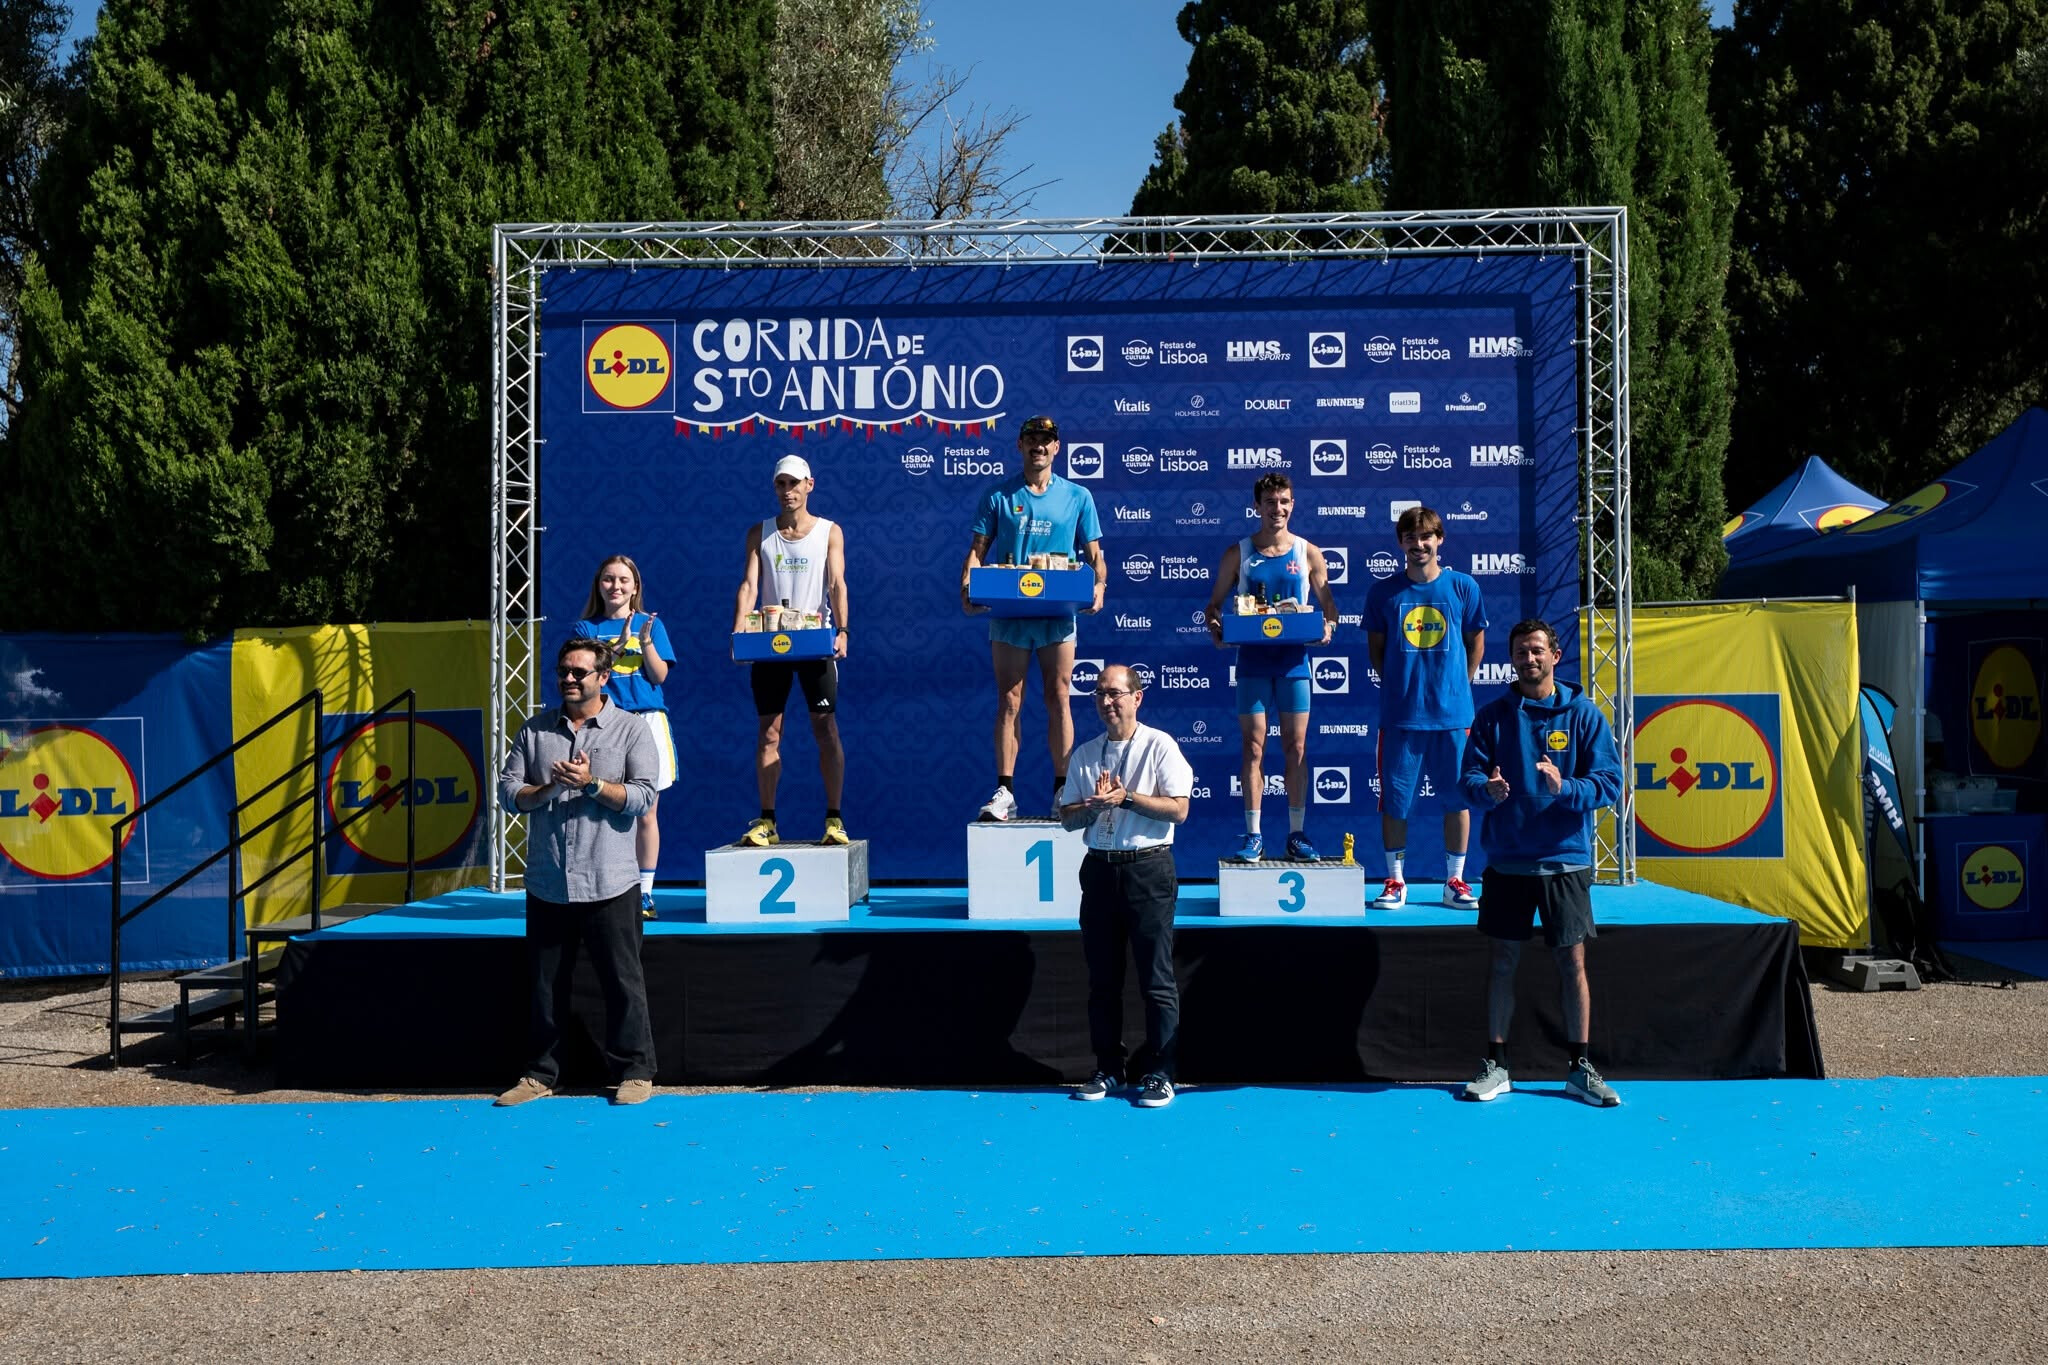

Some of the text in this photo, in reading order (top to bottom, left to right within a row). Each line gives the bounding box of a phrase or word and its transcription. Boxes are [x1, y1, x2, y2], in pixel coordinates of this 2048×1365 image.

[692, 317, 925, 363] CORRIDA DE
[1402, 337, 1439, 345] Festas de
[1121, 346, 1154, 355] LISBOA
[1159, 341, 1196, 350] Festas de
[1226, 340, 1281, 357] HMS
[1364, 343, 1396, 351] LISBOA
[1469, 337, 1523, 354] HMS
[1159, 350, 1208, 364] Lisboa
[1258, 353, 1291, 361] SPORTS
[1402, 346, 1451, 361] Lisboa
[1501, 349, 1534, 357] SPORTS
[692, 358, 1005, 413] STO ANTÓNIO
[1114, 398, 1150, 412] Vitalis
[1245, 400, 1291, 410] DOUBLET
[1320, 398, 1365, 408] RUNNERS
[944, 446, 990, 456] Festas de
[1160, 448, 1197, 456] Festas de
[1403, 445, 1440, 453] Festas de
[1470, 445, 1524, 462] HMS
[901, 454, 935, 463] LISBOA
[1122, 454, 1154, 462] LISBOA
[1227, 448, 1282, 465] HMS
[1365, 451, 1397, 459] LISBOA
[1160, 457, 1208, 472] Lisboa
[1259, 460, 1292, 468] SPORTS
[1403, 454, 1452, 469] Lisboa
[1502, 458, 1535, 466] SPORTS
[943, 458, 1005, 476] Lisboa
[1114, 505, 1151, 519] Vitalis
[1321, 506, 1365, 515] RUNNERS
[1161, 555, 1198, 564] Festas de
[1366, 558, 1399, 567] LISBOA
[1471, 553, 1525, 570] HMS
[1122, 561, 1155, 570] LISBOA
[1504, 566, 1536, 574] SPORTS
[1160, 565, 1209, 580] Lisboa
[1115, 613, 1151, 628] Vitalis
[1161, 665, 1199, 673] Festas de
[1473, 663, 1518, 680] HM
[1161, 674, 1210, 689] Lisboa
[1323, 725, 1368, 735] RUNNERS
[1230, 775, 1285, 792] HS
[1025, 840, 1054, 902] 1
[759, 858, 796, 914] 2
[1277, 871, 1306, 913] 3
